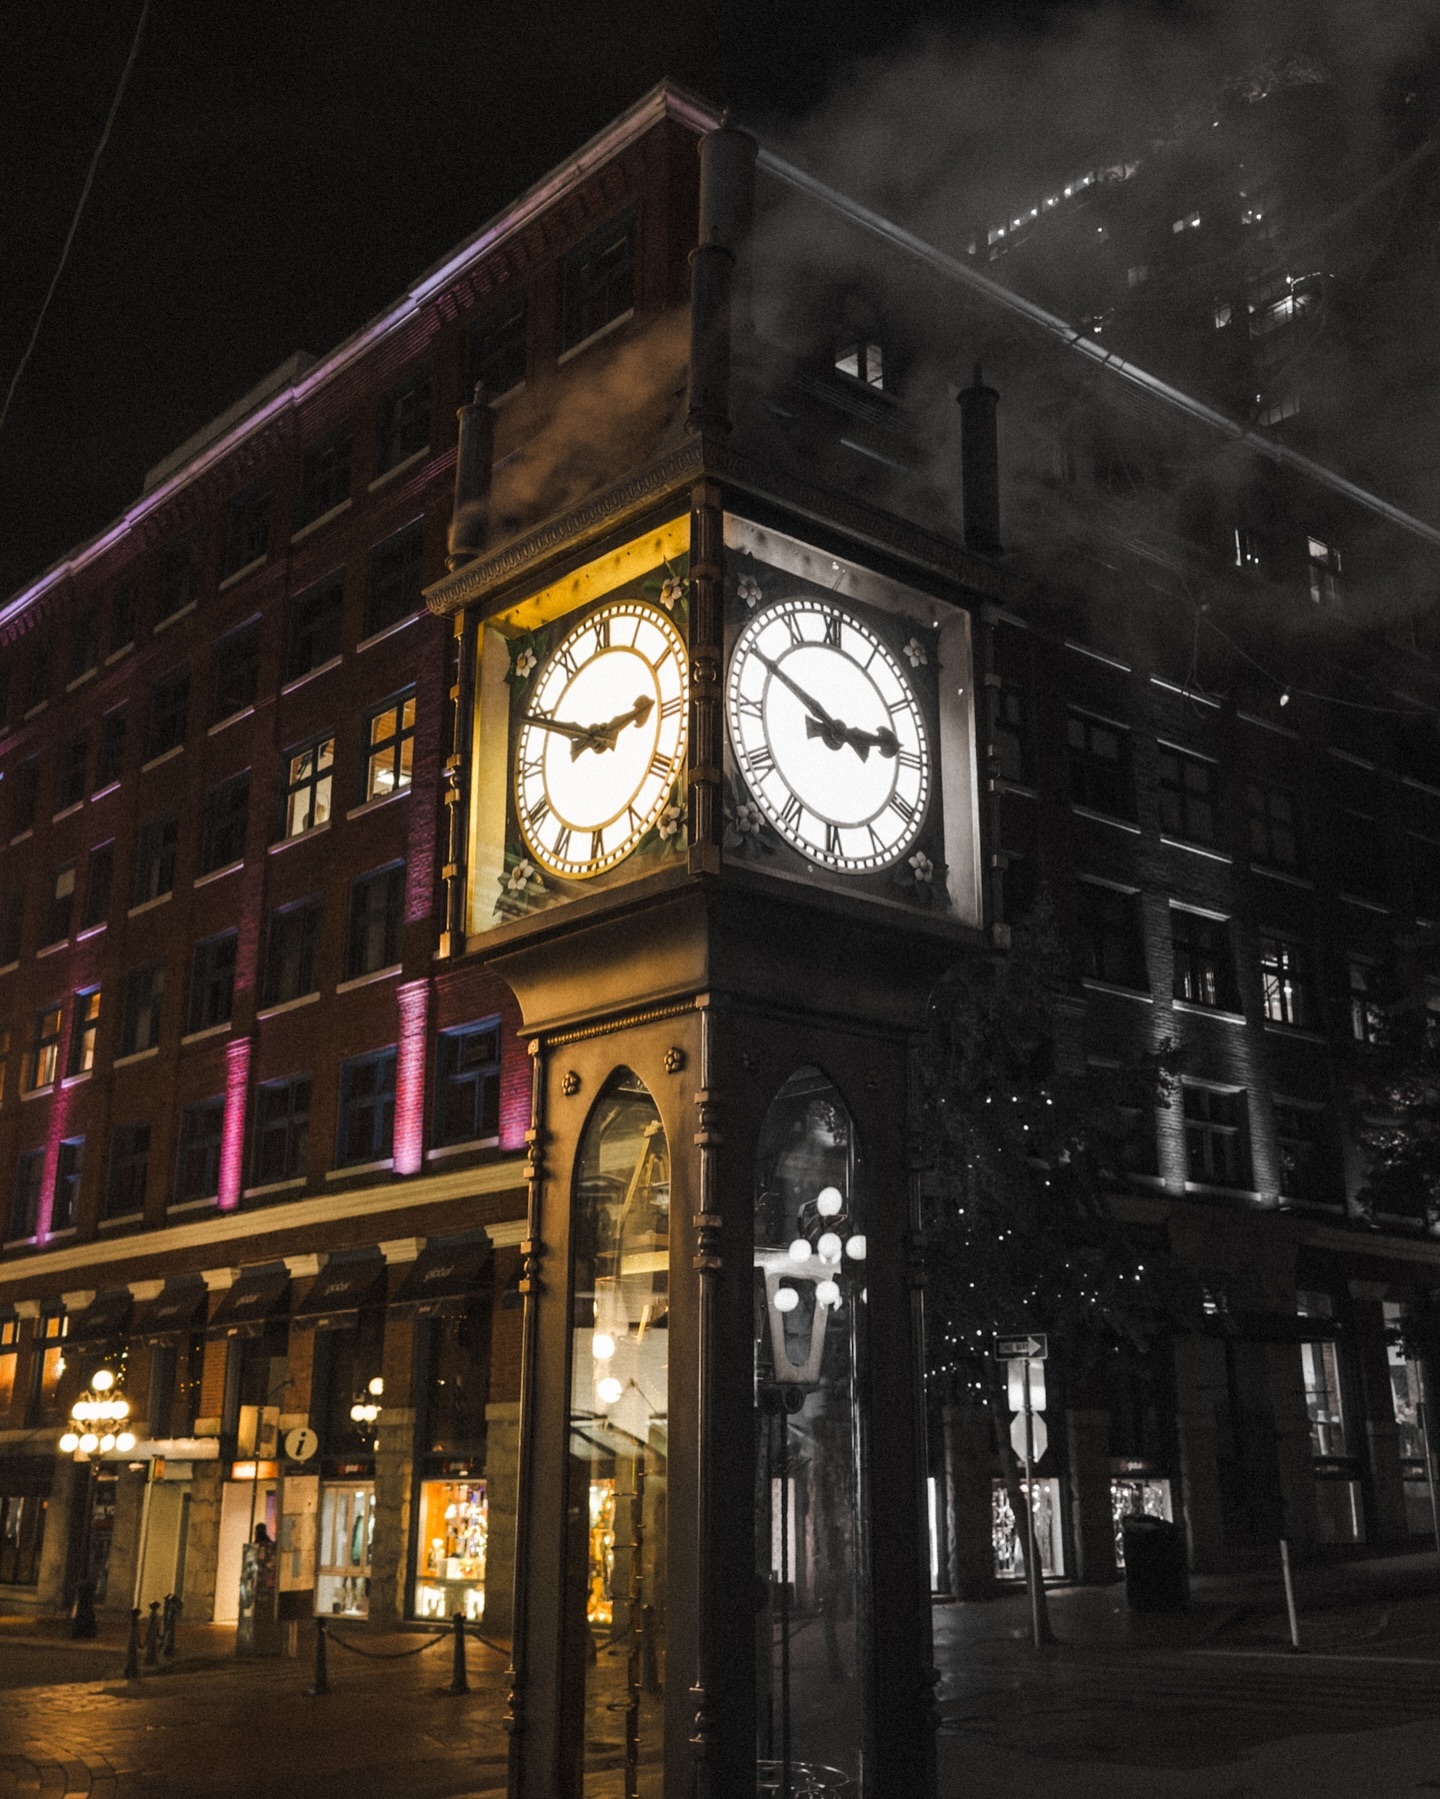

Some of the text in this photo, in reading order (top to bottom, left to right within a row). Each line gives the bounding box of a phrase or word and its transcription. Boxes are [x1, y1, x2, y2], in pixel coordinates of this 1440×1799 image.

[594, 619, 610, 651] XII
[632, 619, 641, 649] I
[781, 612, 804, 645] XI
[823, 614, 842, 649] XII
[558, 649, 578, 681] XI
[653, 645, 672, 672] II
[865, 647, 877, 671] I
[660, 696, 682, 720] III
[739, 692, 763, 720] IX
[888, 699, 910, 716] II
[523, 754, 544, 780] IX
[649, 751, 673, 780] IIII
[748, 744, 776, 784] VIII
[899, 749, 921, 771] III
[627, 804, 643, 833] V
[781, 793, 804, 833] VII
[887, 791, 914, 825] IIII
[591, 828, 605, 861] VI
[826, 823, 844, 857] VI
[866, 824, 887, 855] V
